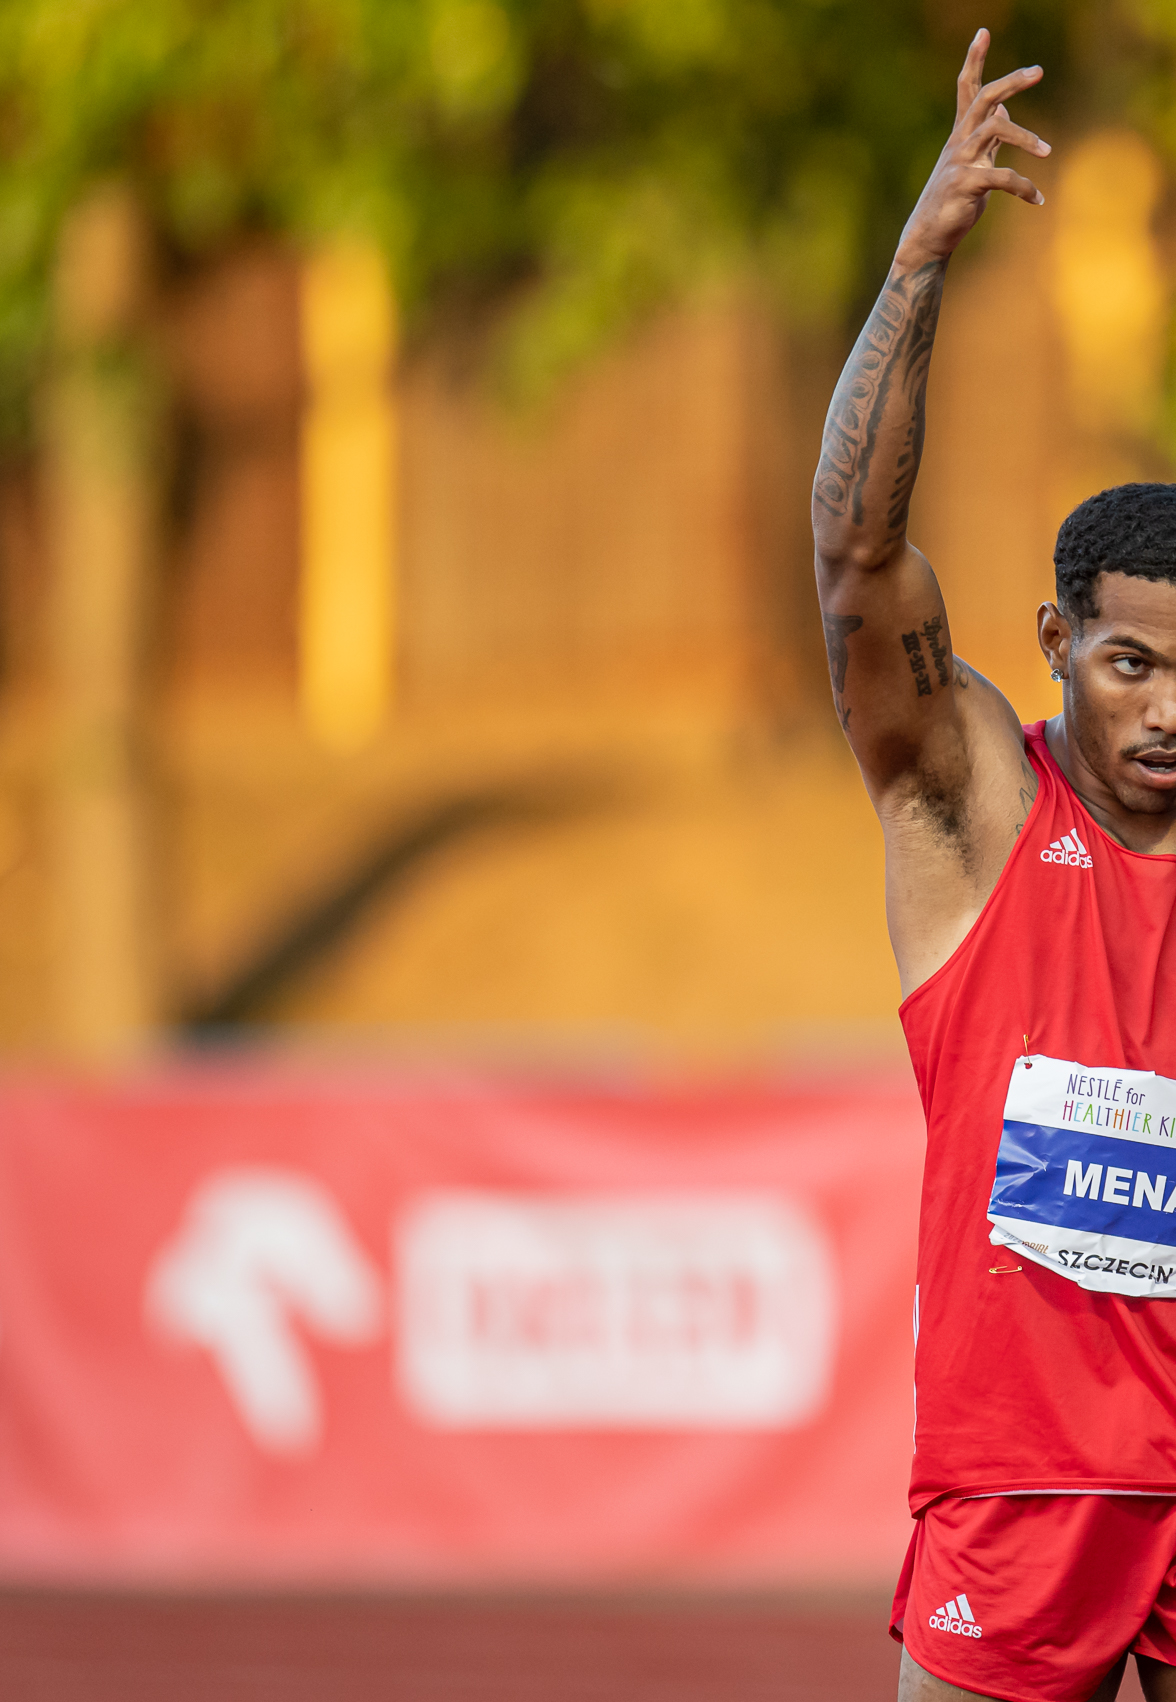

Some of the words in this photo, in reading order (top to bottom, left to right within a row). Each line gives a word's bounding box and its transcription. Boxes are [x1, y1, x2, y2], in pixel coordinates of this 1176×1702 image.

[1040, 849, 1093, 869] adidas
[1066, 1073, 1123, 1102] NESTLÉ
[1126, 1087, 1146, 1106] for
[1062, 1100, 1152, 1134] HEALTHIER
[1058, 1249, 1174, 1284] SZCZECIN
[928, 1615, 983, 1639] adidas
